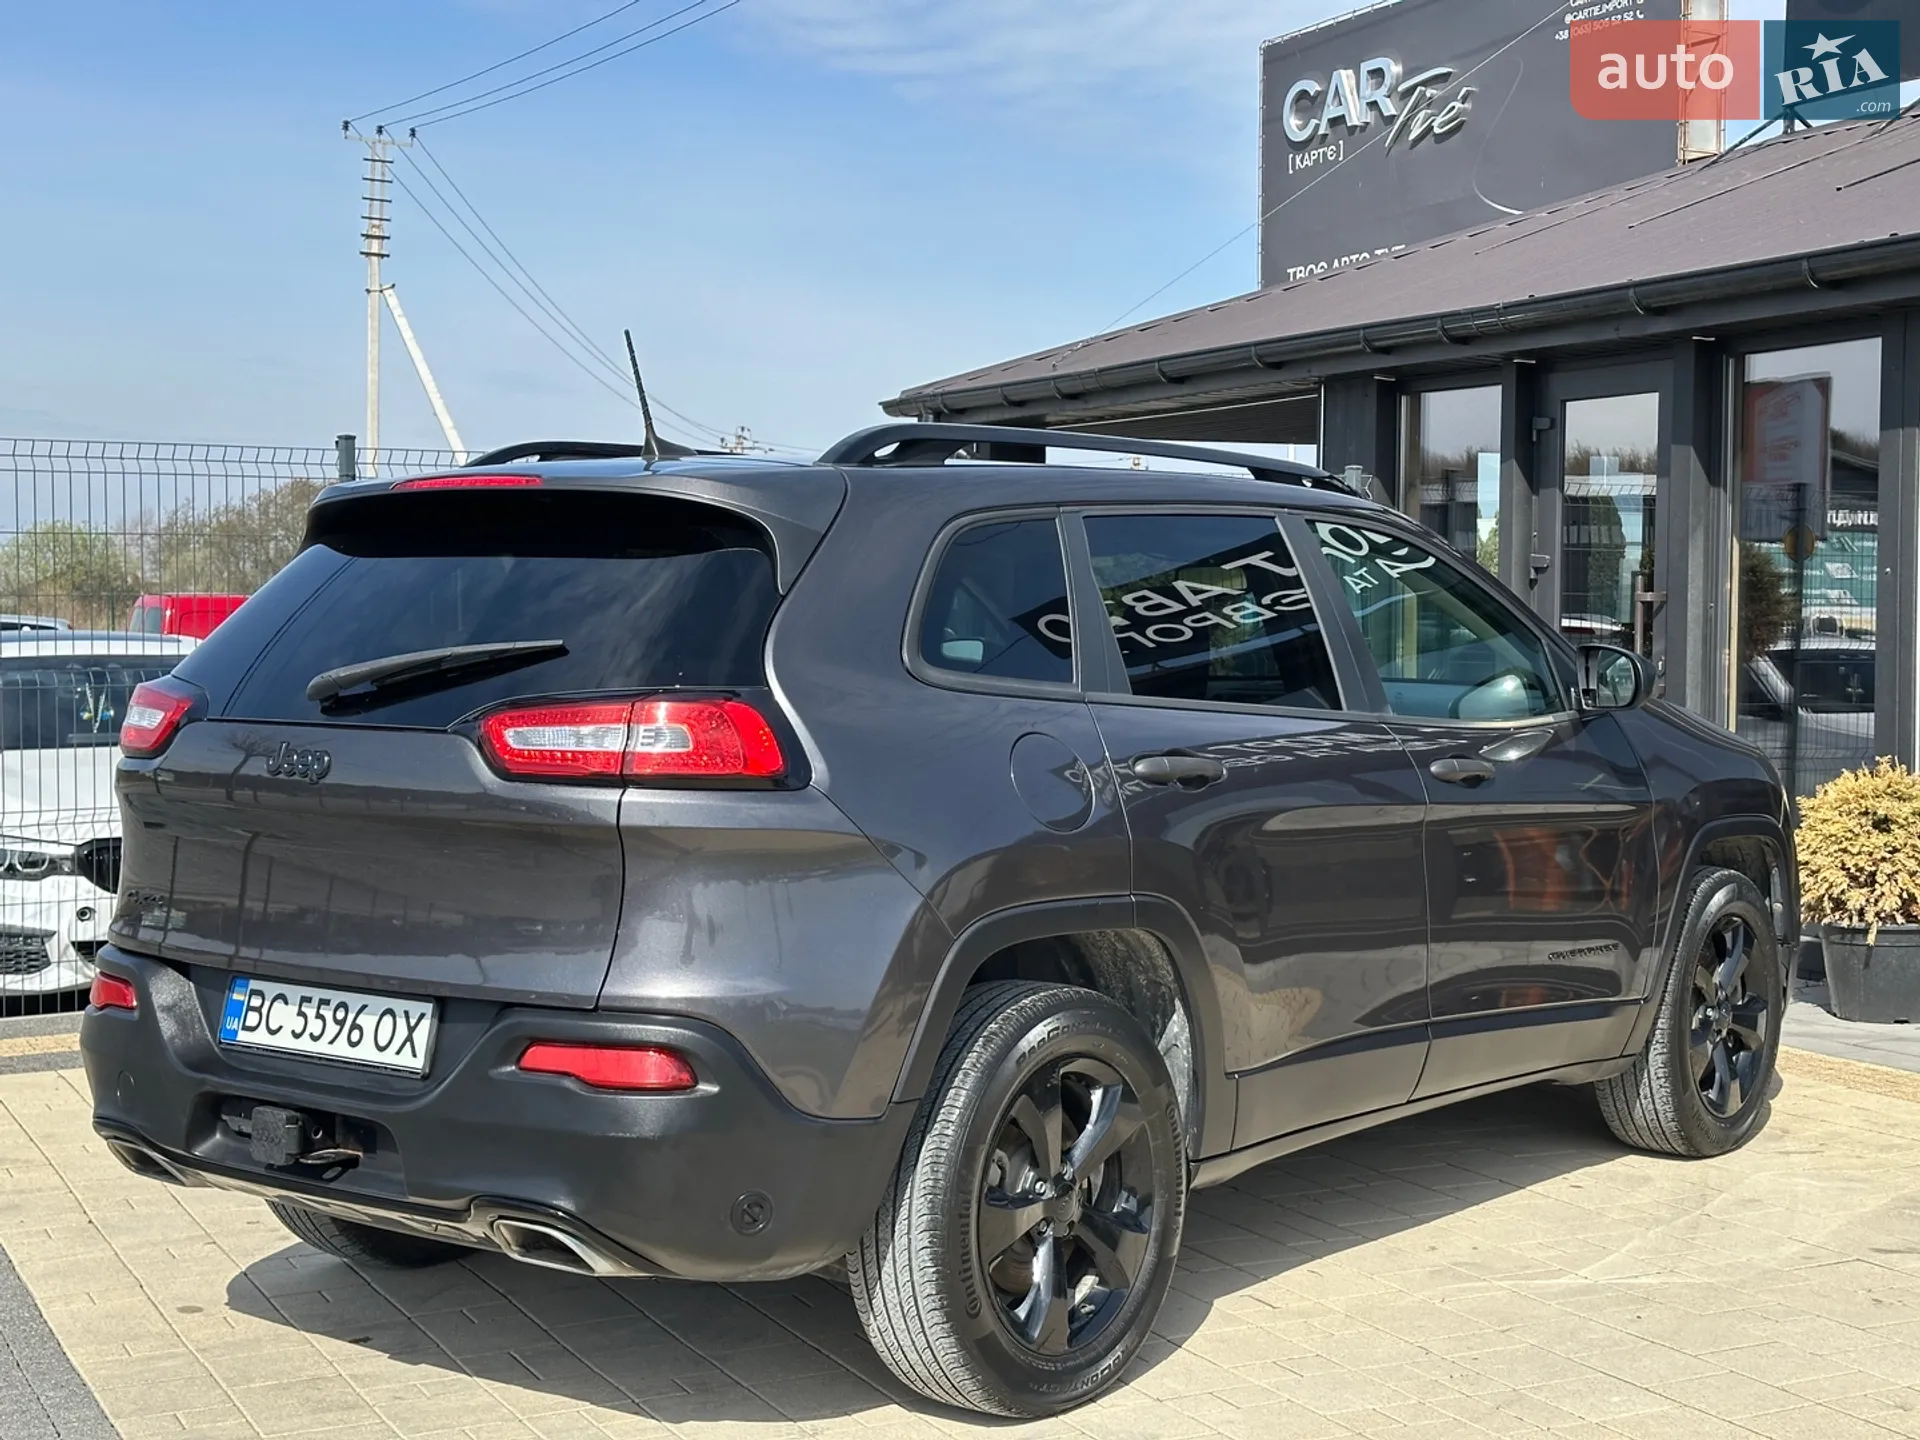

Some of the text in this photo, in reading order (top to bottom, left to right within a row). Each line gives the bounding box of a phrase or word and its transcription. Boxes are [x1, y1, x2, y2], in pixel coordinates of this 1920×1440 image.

[1283, 57, 1402, 143] CAR
[265, 741, 332, 785] Jeep
[225, 1015, 239, 1031] UA
[240, 988, 427, 1058] BC 5596 OX
